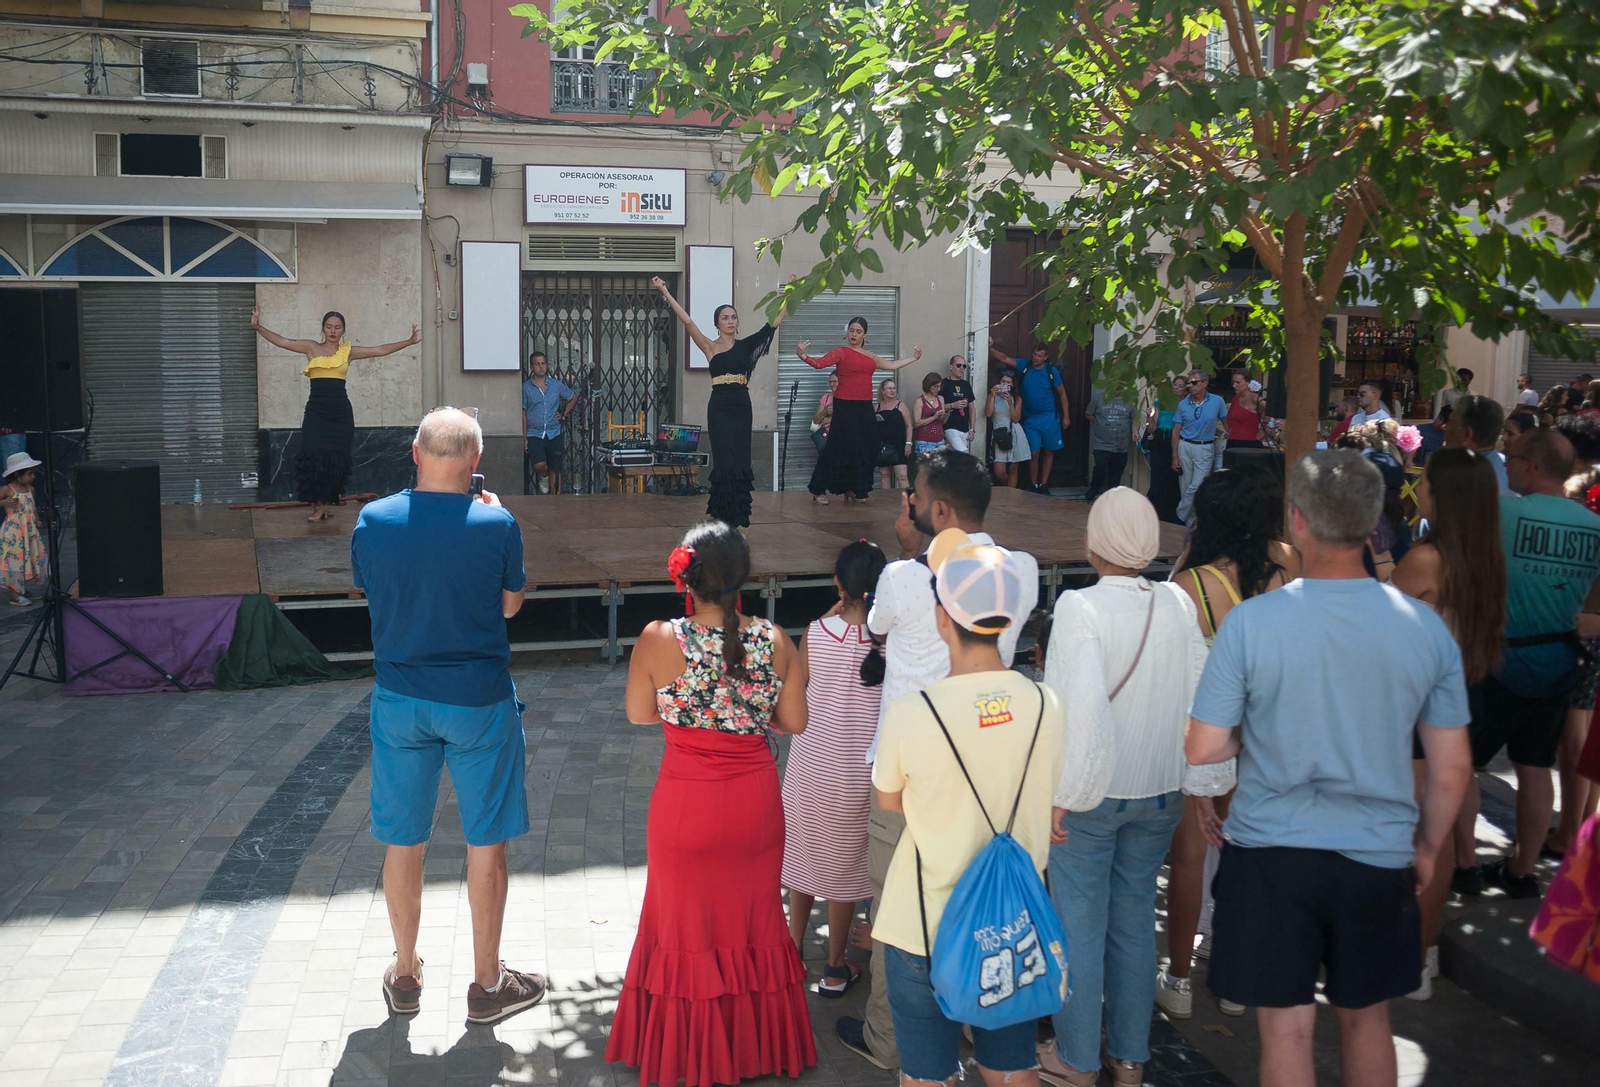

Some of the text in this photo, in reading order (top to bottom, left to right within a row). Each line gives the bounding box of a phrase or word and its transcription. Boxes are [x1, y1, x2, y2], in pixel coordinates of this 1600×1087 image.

[560, 171, 653, 181] OPERACIÓN ASESORADA
[533, 194, 609, 204] EUROBIENES
[1520, 524, 1600, 562] HOLLISTER
[973, 695, 1011, 718] TOY
[979, 923, 1047, 1007] 93
